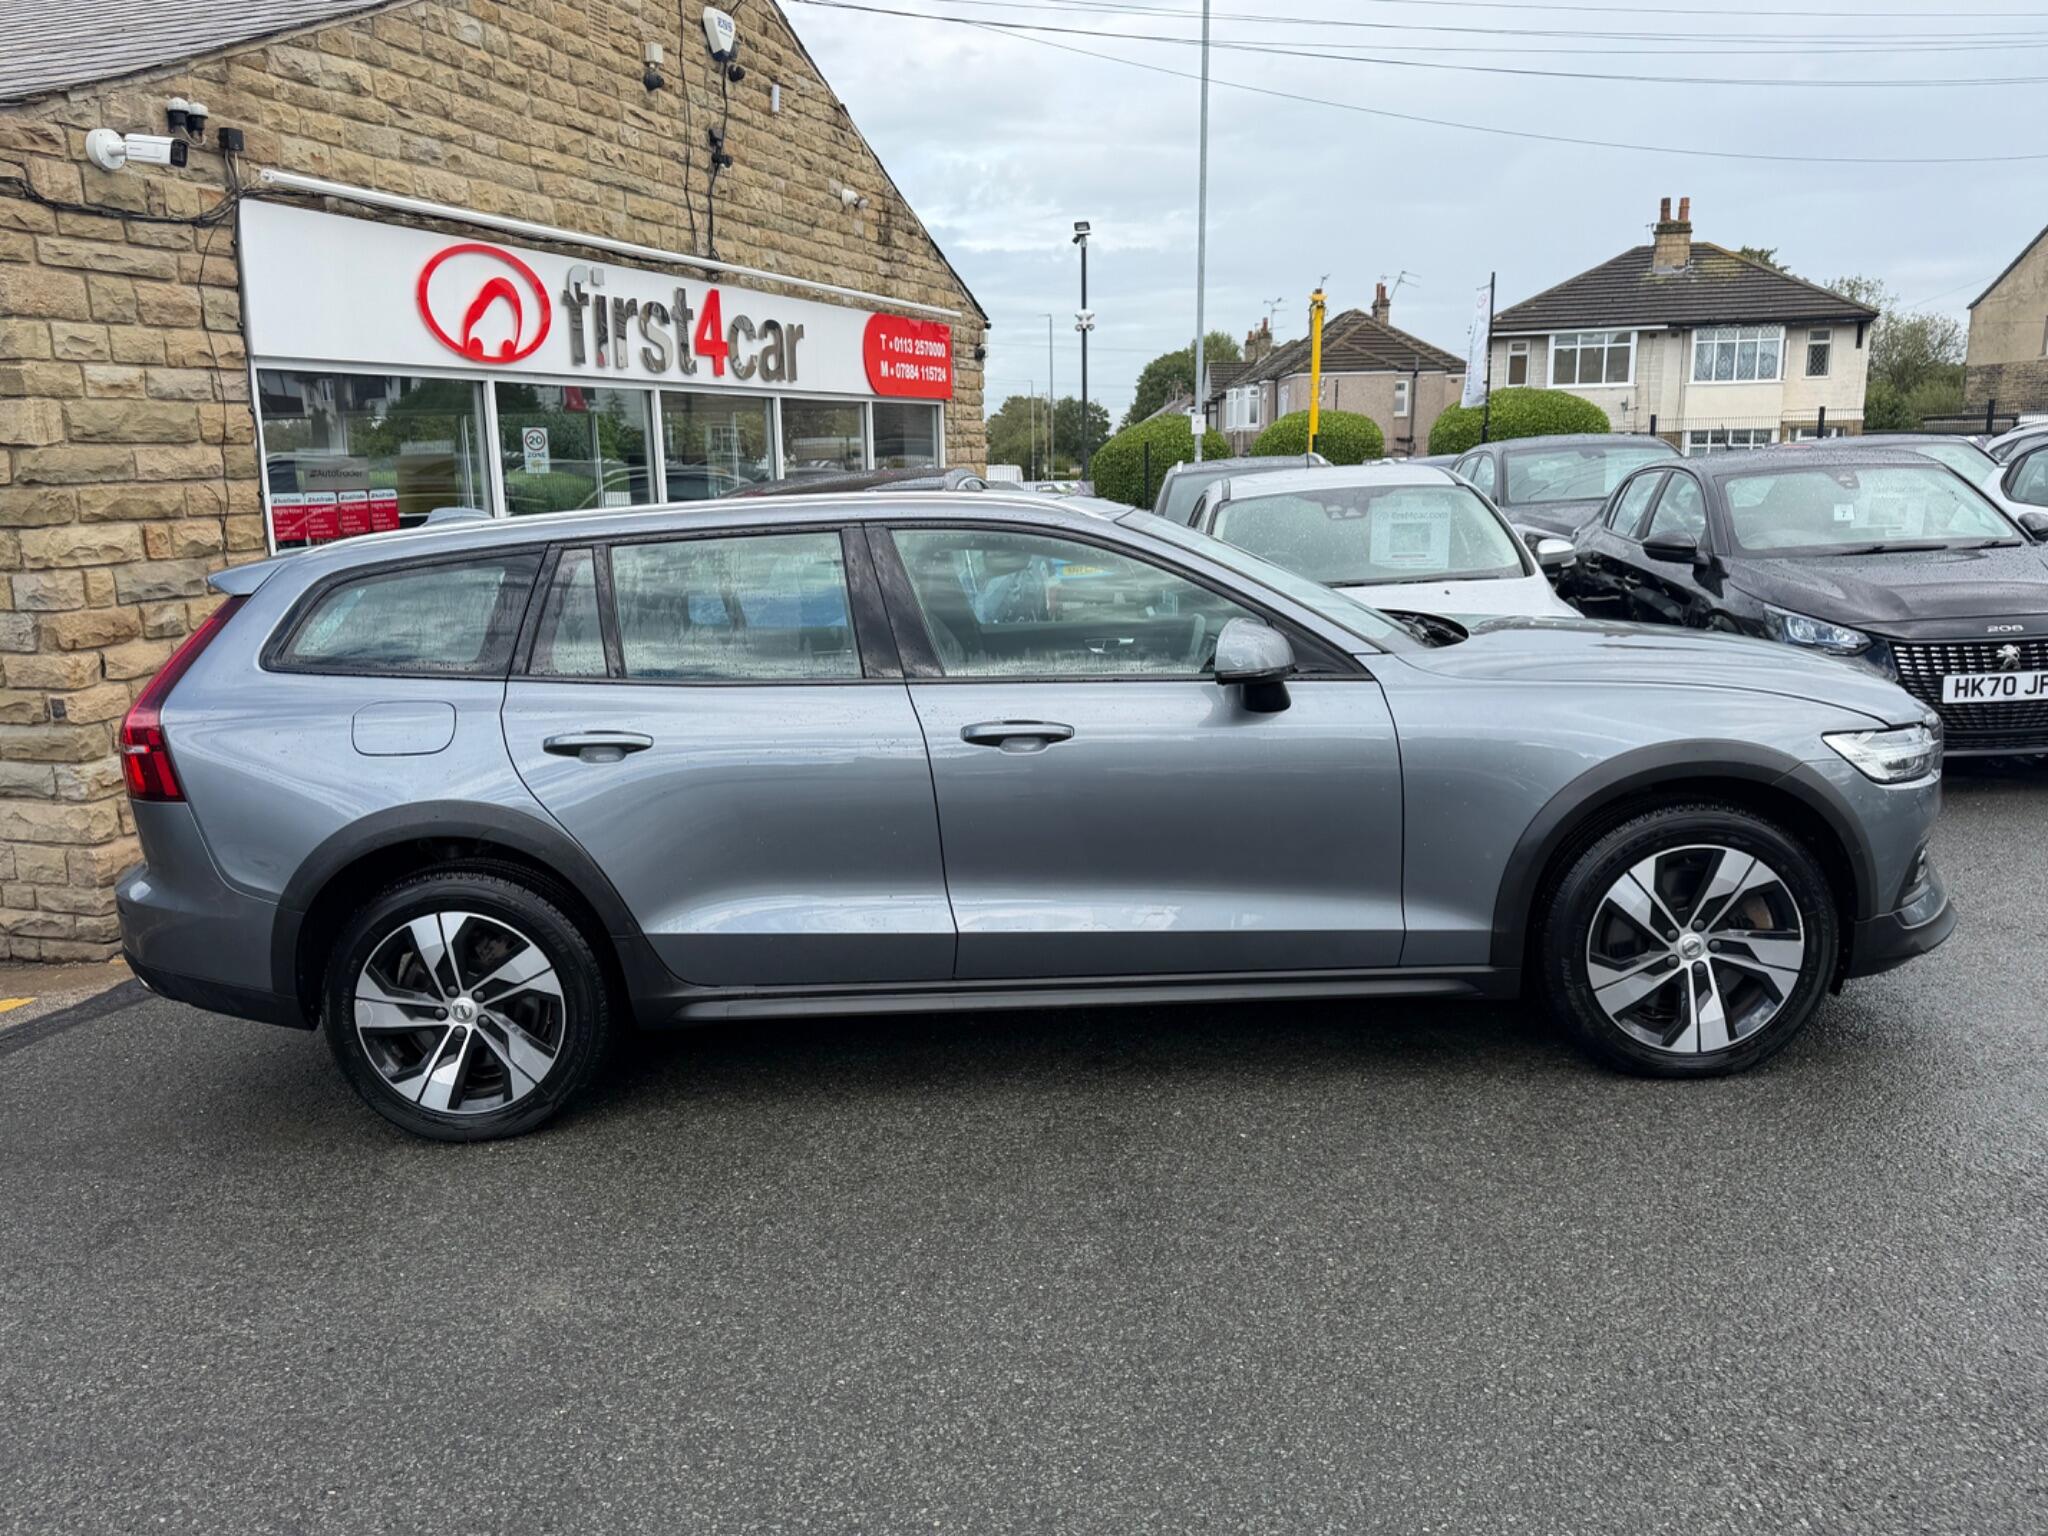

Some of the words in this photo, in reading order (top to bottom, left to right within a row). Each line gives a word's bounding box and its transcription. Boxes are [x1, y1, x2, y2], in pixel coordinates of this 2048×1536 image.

[561, 265, 804, 383] first4car
[880, 334, 887, 351] T
[894, 336, 913, 354] 0113
[914, 339, 946, 358] 2570000
[880, 360, 889, 377] M
[921, 364, 947, 382] 115724
[528, 436, 543, 445] 20
[1954, 676, 2017, 698] HK70
